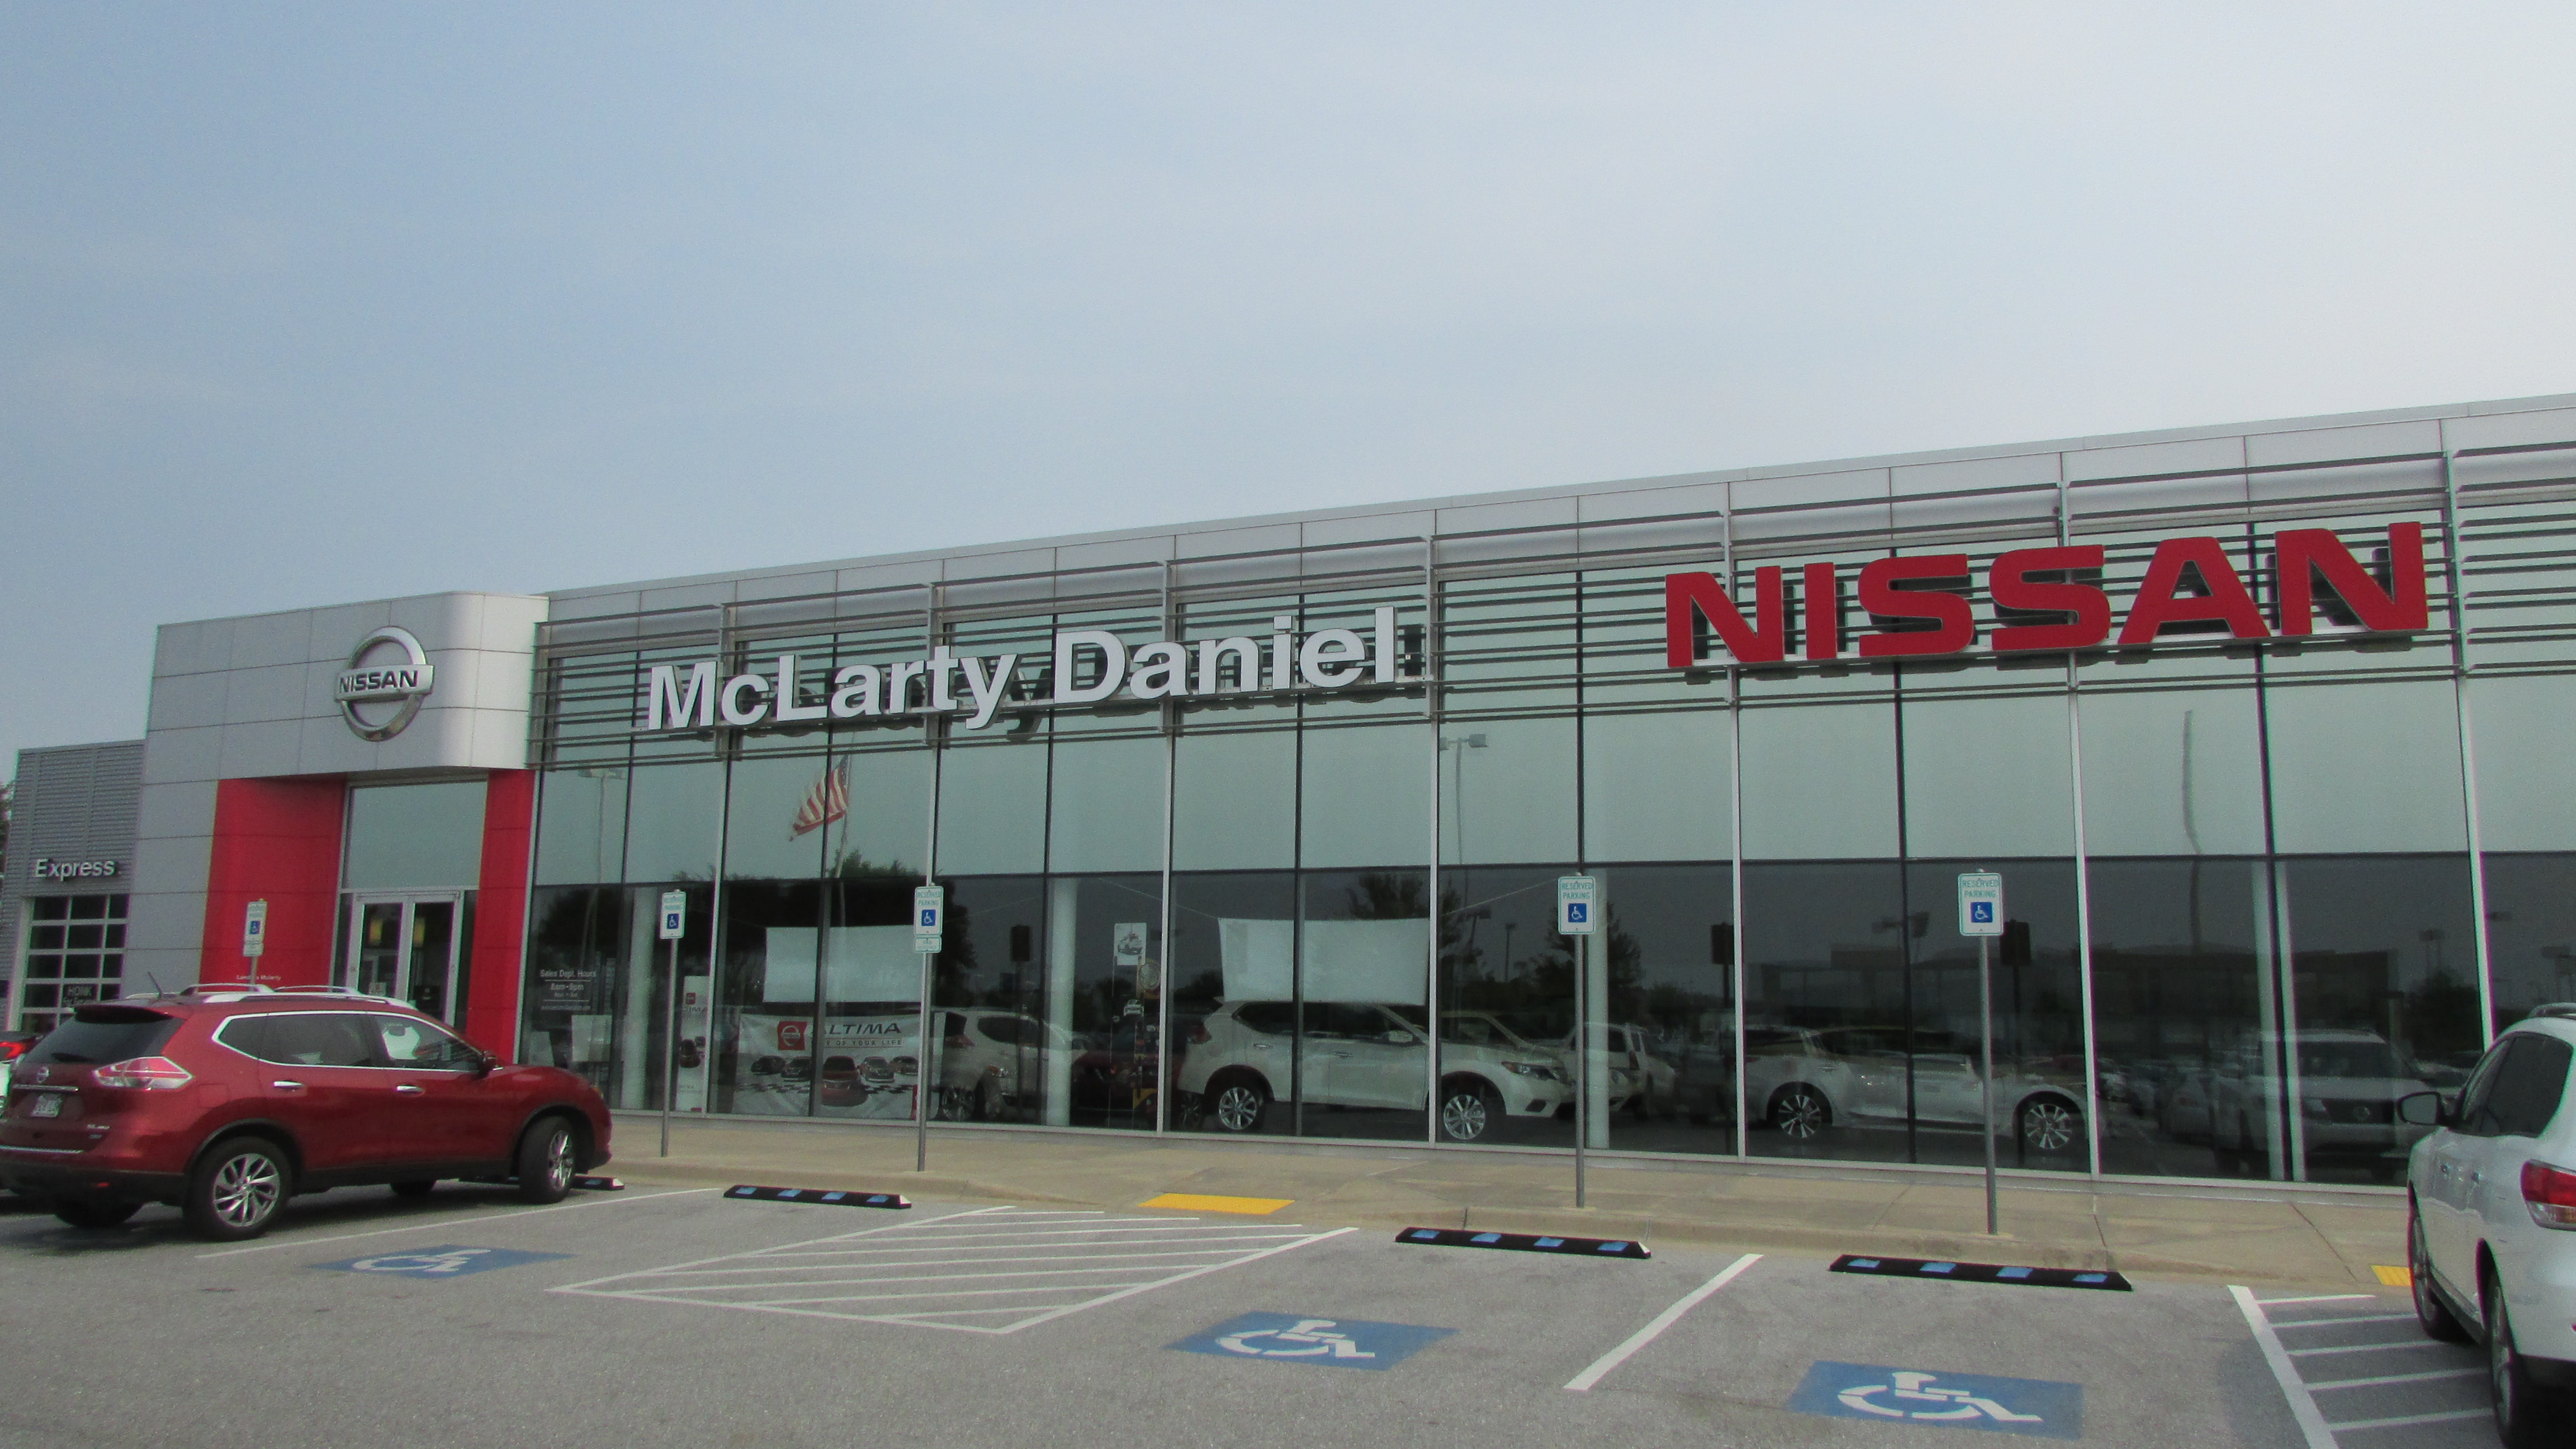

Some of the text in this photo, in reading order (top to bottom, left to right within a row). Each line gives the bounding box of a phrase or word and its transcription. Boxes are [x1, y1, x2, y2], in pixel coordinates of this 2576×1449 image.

[1665, 520, 2428, 669] NISSAN
[647, 605, 1398, 730] McLarty Daniel
[339, 670, 419, 694] NISSAN
[35, 858, 116, 882] Express
[1962, 879, 1999, 888] RESERVED
[1964, 889, 1997, 898] PARKING
[823, 1022, 901, 1035] LTIMA
